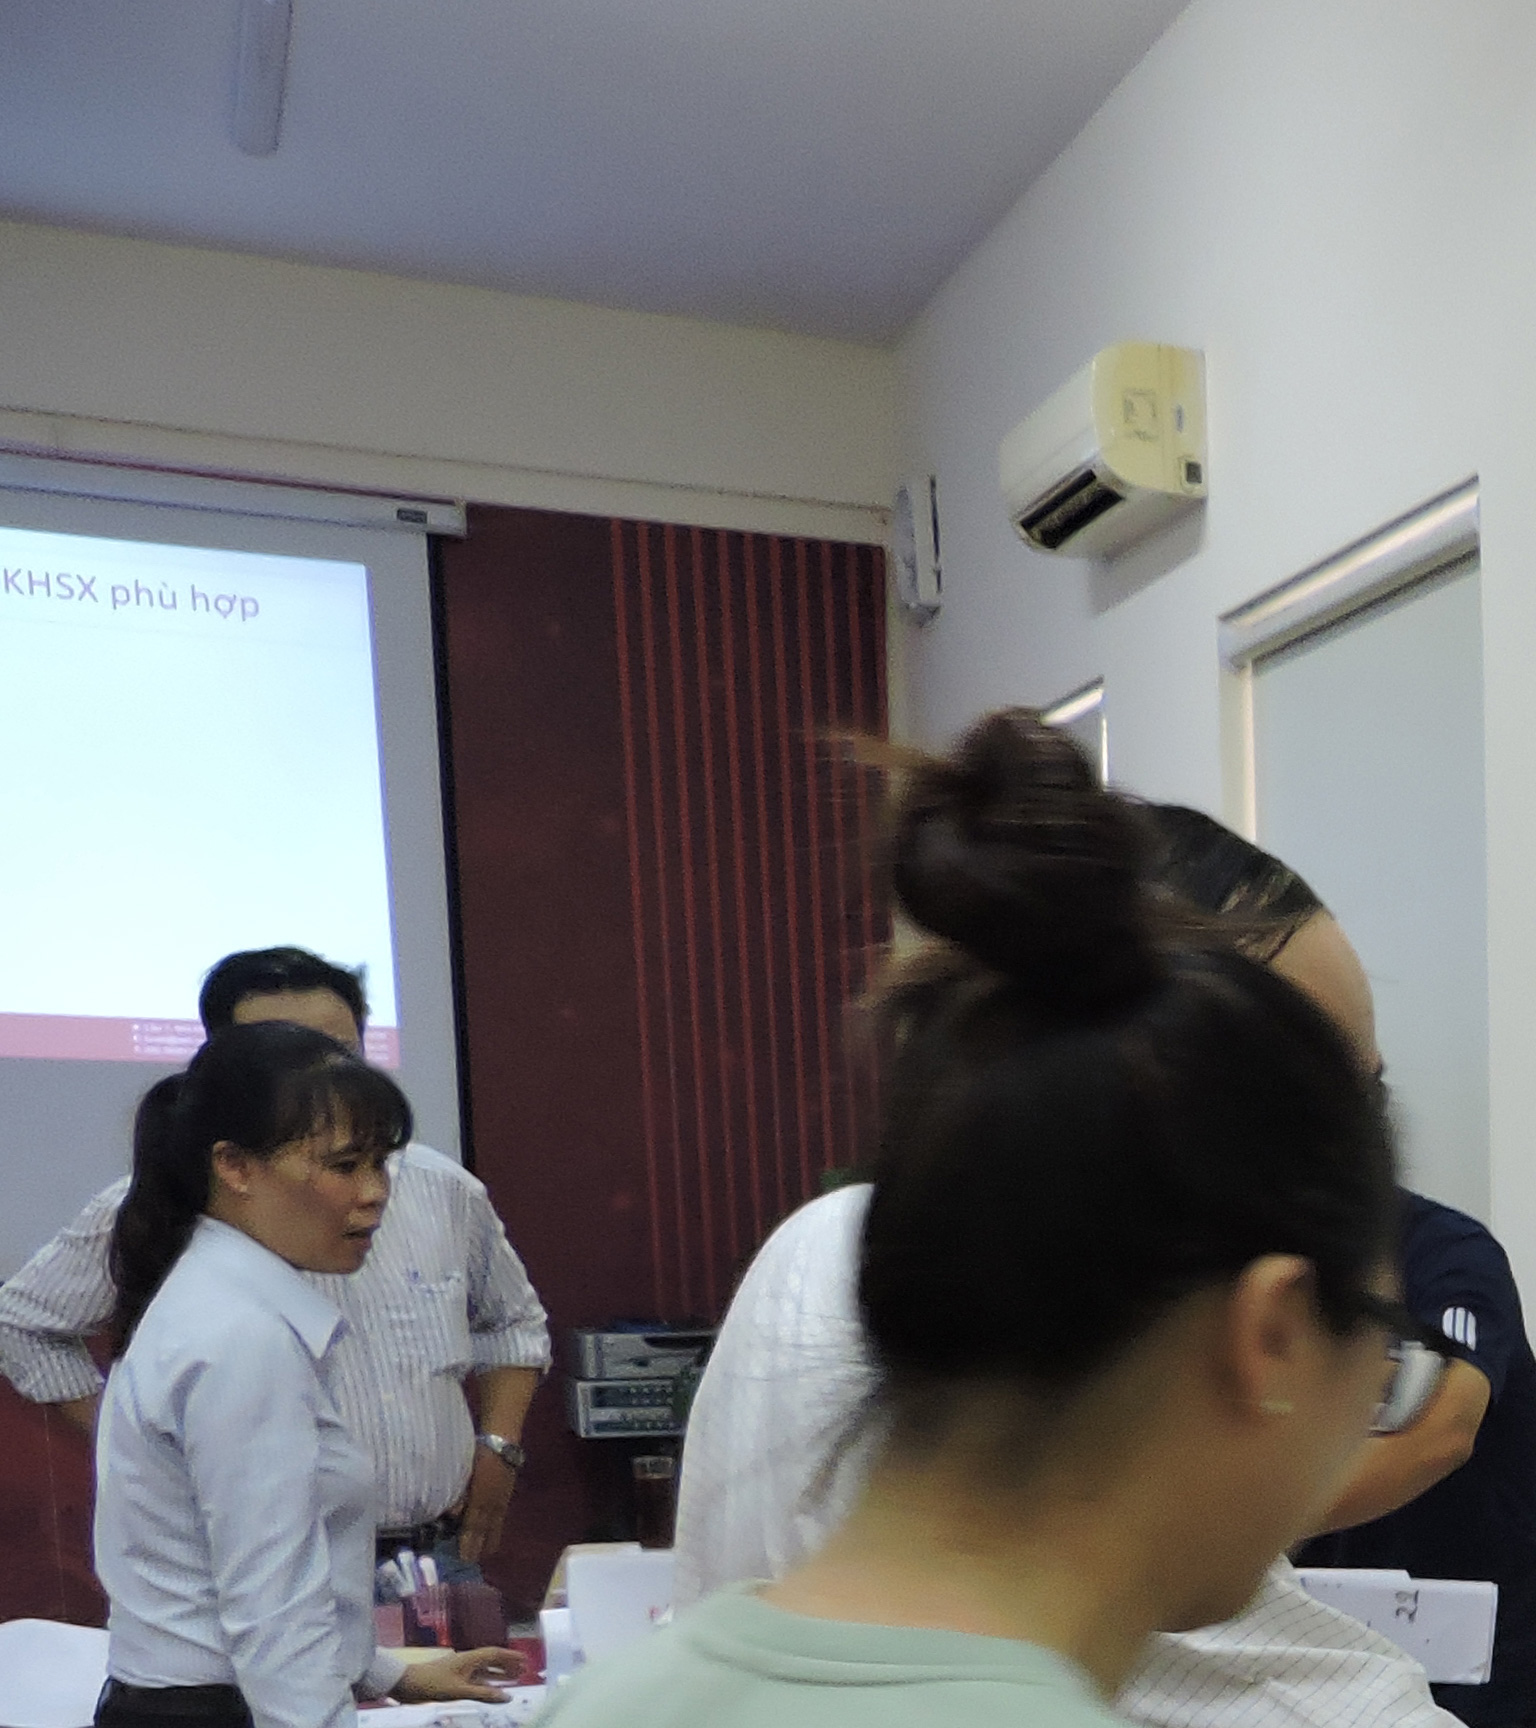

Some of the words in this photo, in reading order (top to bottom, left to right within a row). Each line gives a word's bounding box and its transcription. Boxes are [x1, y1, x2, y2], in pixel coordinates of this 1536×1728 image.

[3, 567, 98, 603] KHSX
[110, 578, 177, 611] phù
[190, 583, 260, 622] hợp
